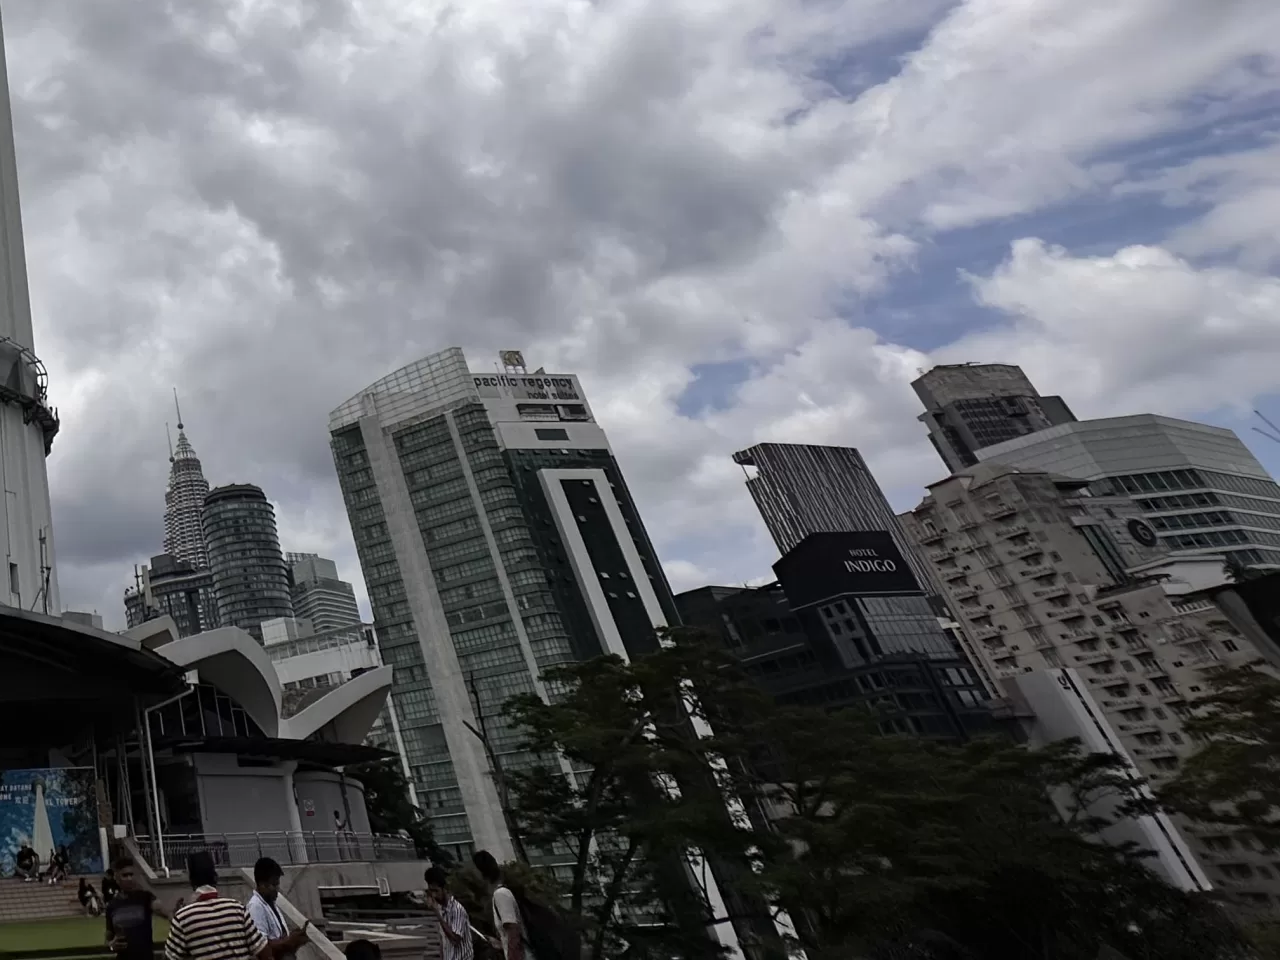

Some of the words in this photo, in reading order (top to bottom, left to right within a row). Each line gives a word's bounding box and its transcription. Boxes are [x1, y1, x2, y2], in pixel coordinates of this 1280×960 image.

[473, 375, 518, 389] pacific
[521, 378, 574, 390] regency
[849, 548, 879, 557] HOTEL
[843, 559, 897, 573] INDIGO
[56, 797, 78, 806] TOWER
